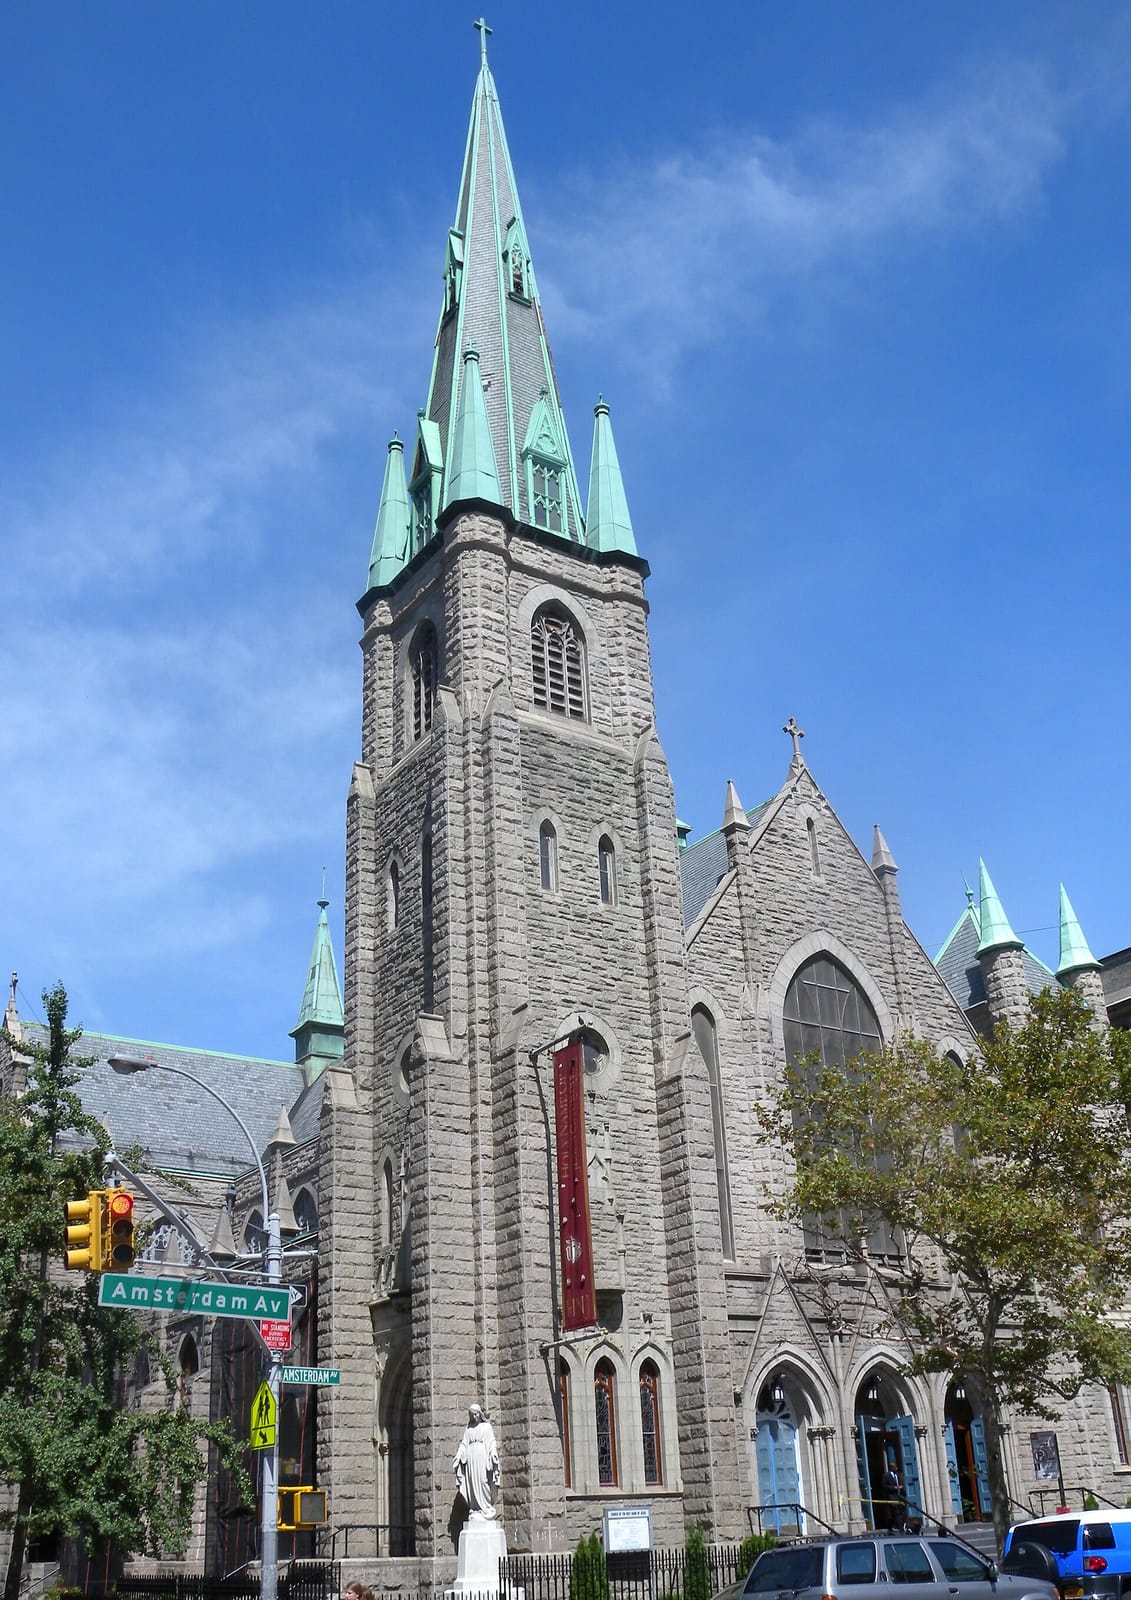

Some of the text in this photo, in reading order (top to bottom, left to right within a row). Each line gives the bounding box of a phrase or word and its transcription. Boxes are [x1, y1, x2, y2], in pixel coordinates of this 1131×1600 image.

[111, 1281, 281, 1313] Amsterdam Av
[270, 1324, 290, 1332] STANDING
[283, 1368, 329, 1383] AMSTERDAM
